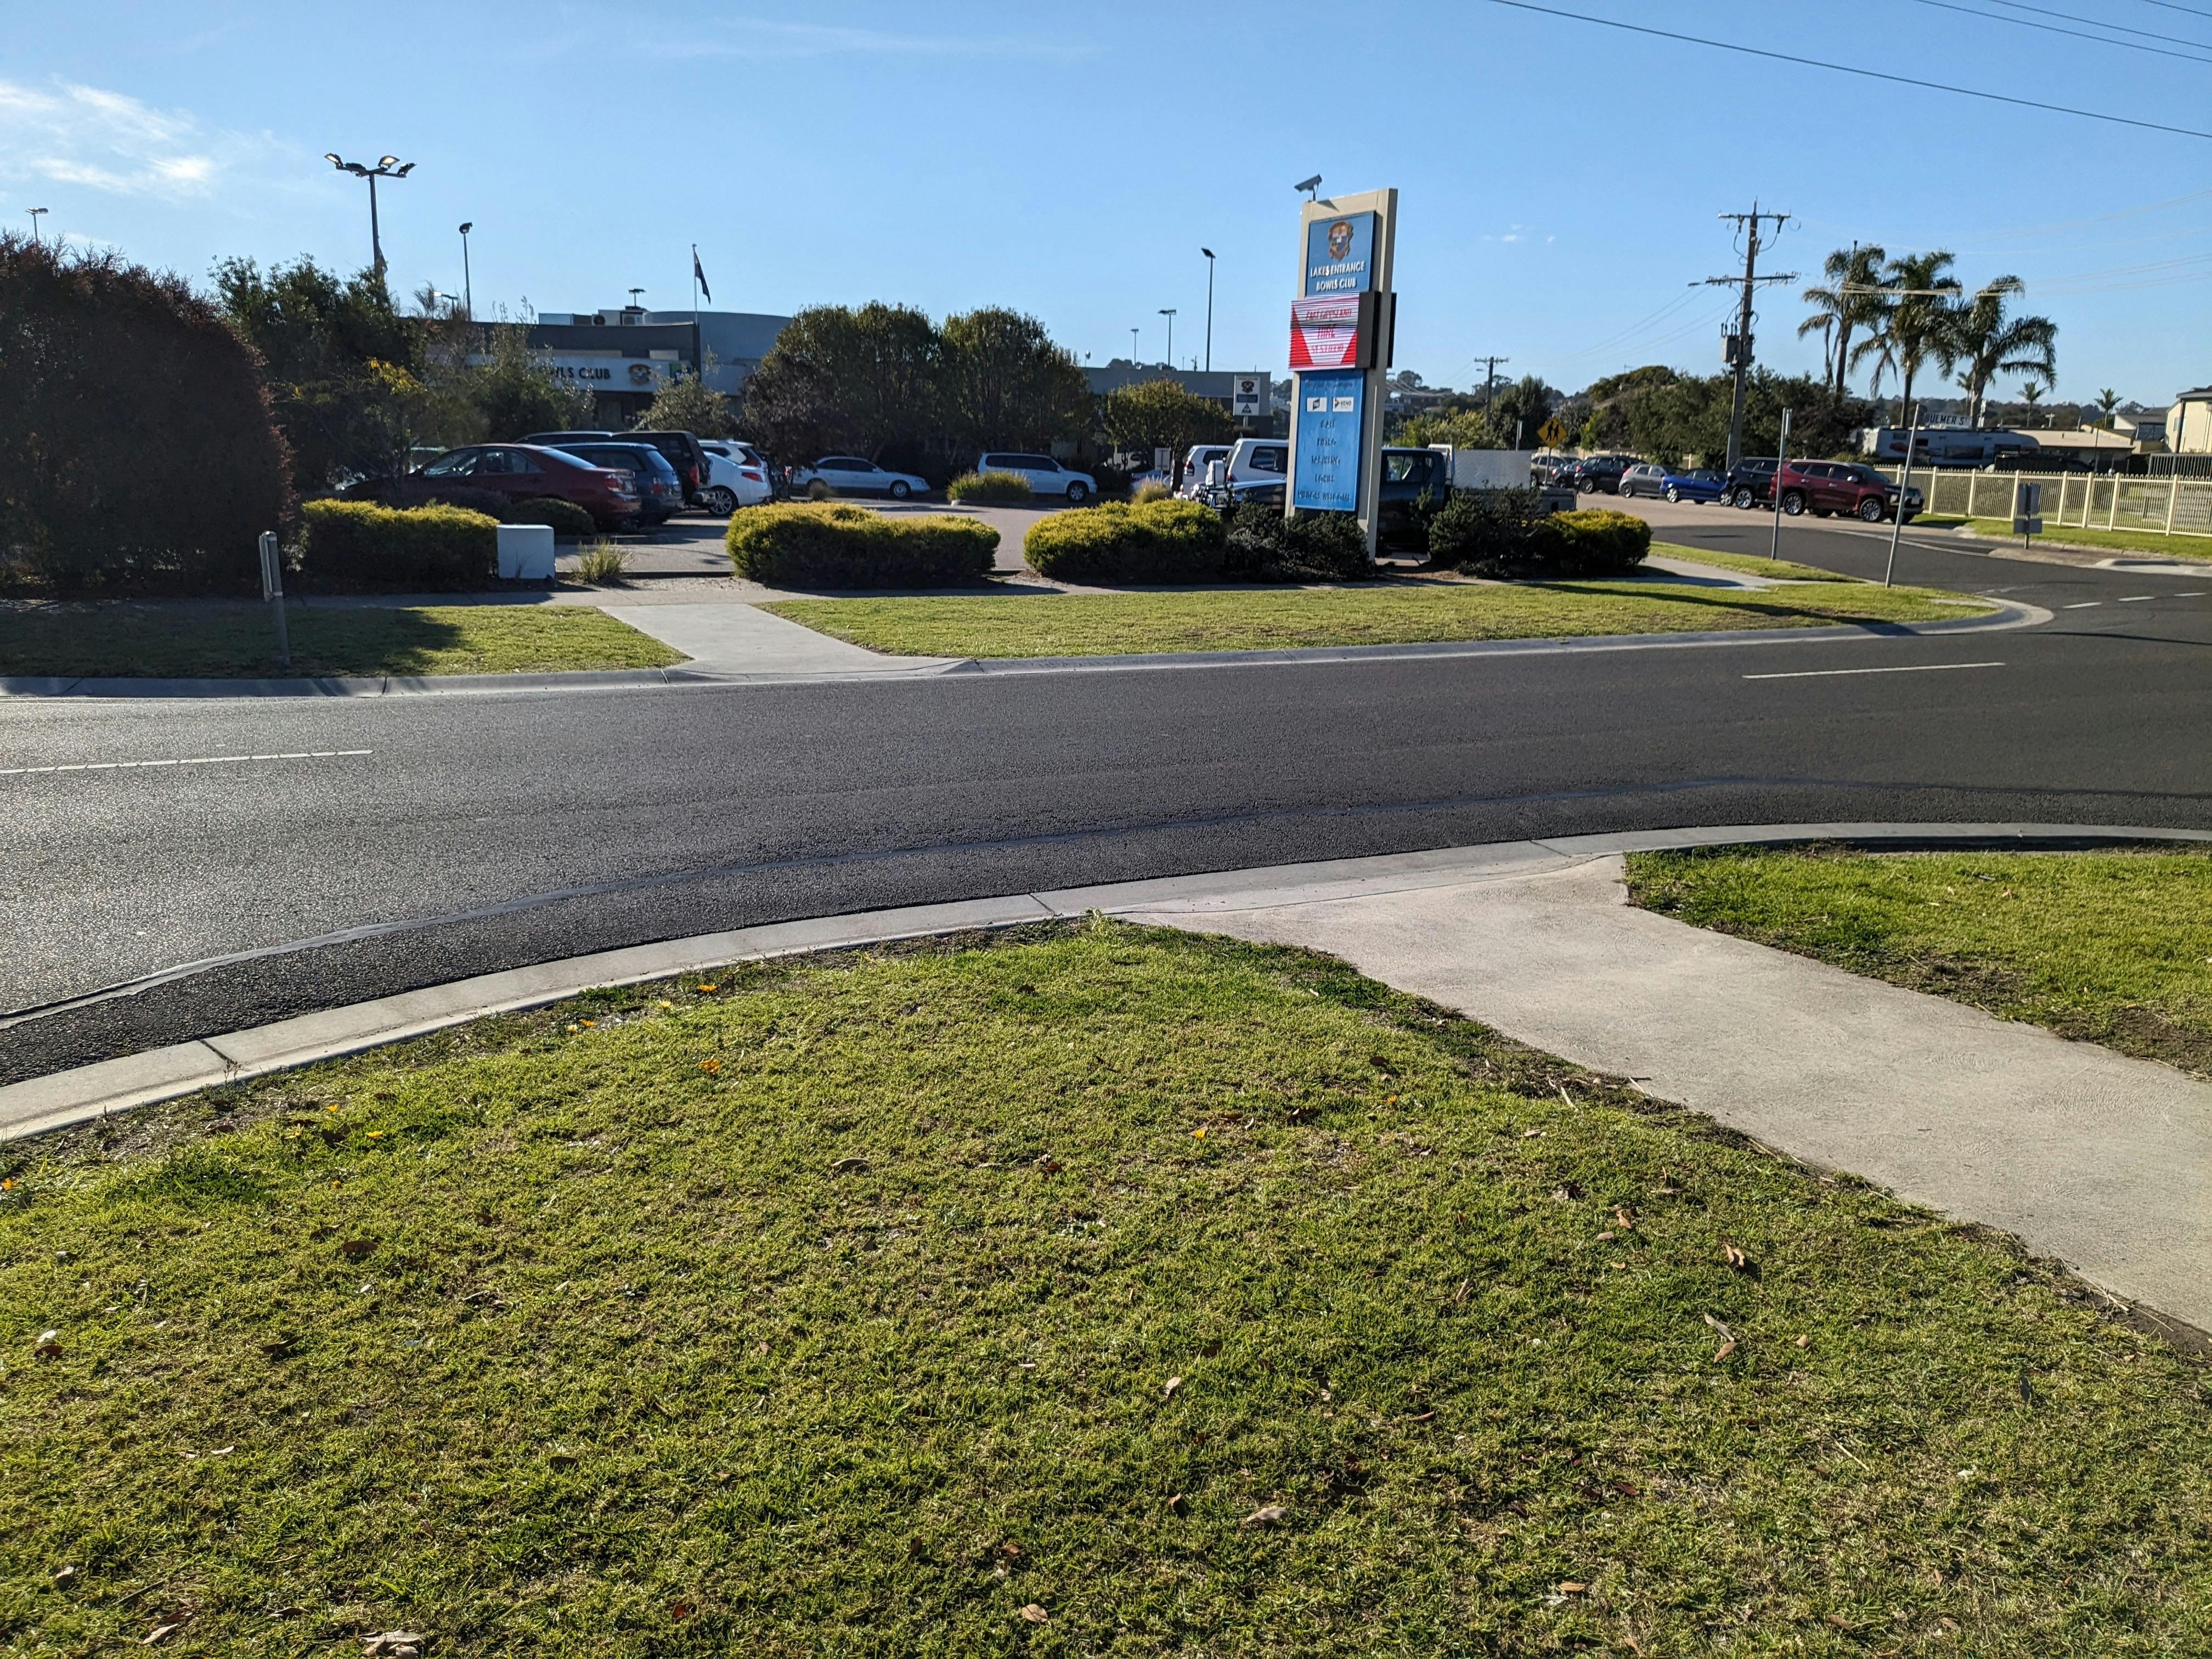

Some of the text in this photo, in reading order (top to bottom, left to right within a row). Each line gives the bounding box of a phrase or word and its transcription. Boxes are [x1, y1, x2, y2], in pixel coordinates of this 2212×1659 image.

[1310, 260, 1365, 278] LAKES ENTRANCE
[1316, 277, 1356, 291] BOWLS CLUB
[579, 367, 611, 380] CLUB
[1925, 413, 1957, 425] BULMER
